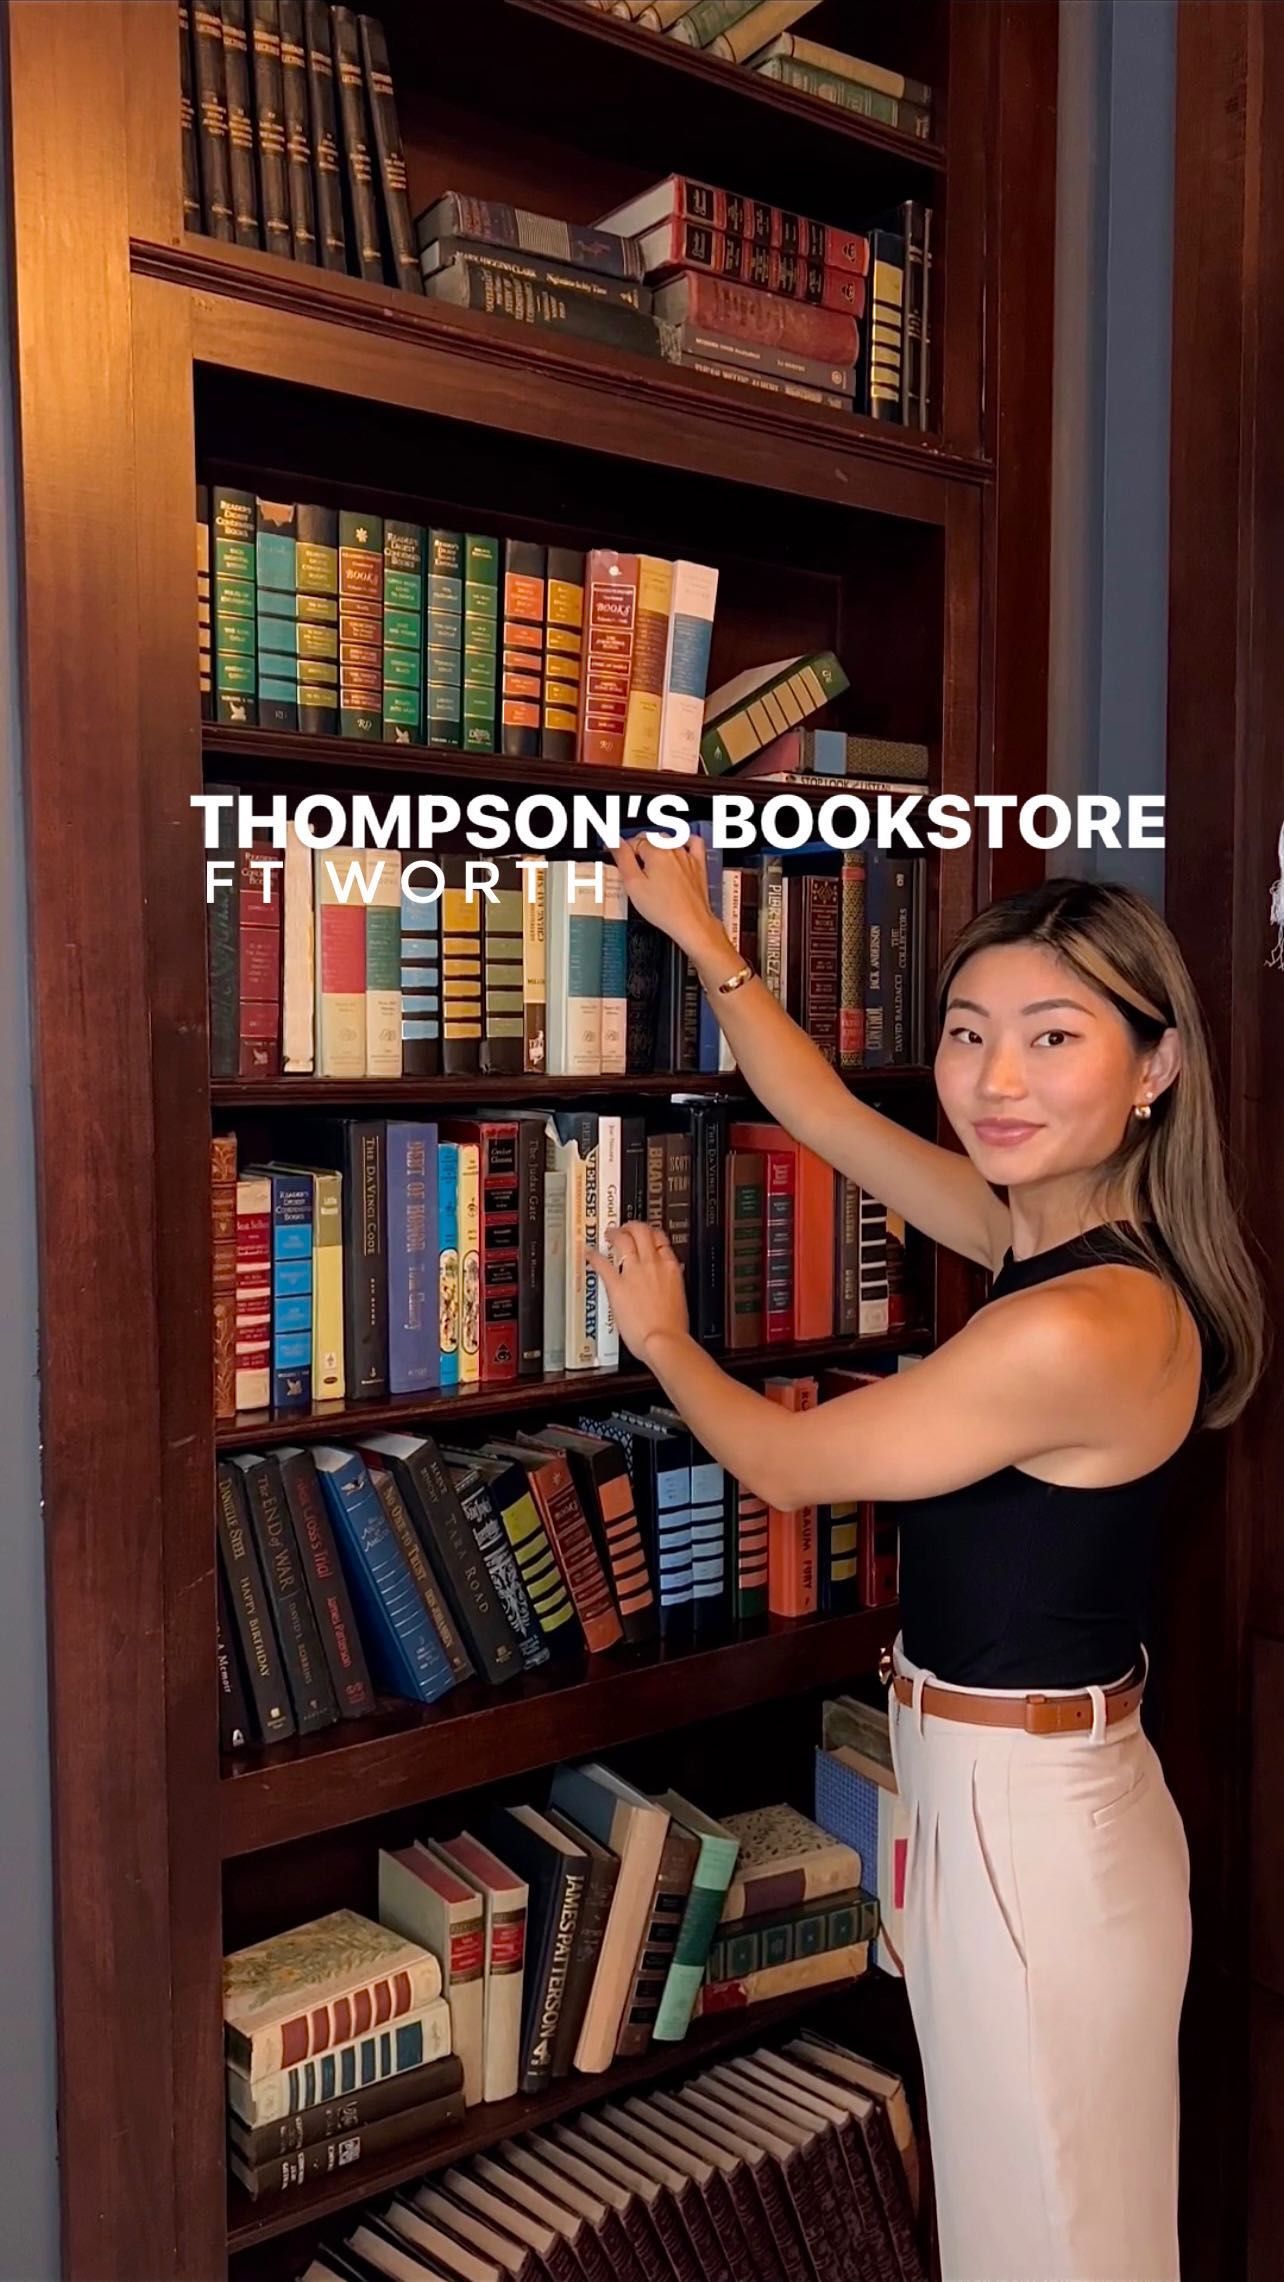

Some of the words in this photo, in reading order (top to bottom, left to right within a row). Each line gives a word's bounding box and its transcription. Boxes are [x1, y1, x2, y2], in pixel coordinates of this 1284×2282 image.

[596, 602, 631, 617] BOOKS
[869, 924, 881, 968] ANDERSON
[899, 907, 908, 969] COLLECTORS
[895, 973, 903, 1022] BALDACCI
[895, 1022, 903, 1053] DAVID
[366, 1138, 376, 1161] THE
[406, 1140, 425, 1177] DEBT
[529, 1140, 539, 1161] The
[529, 1162, 539, 1193] Judas
[648, 1147, 662, 1194] BRAD
[406, 1181, 425, 1200] OF
[528, 1195, 539, 1221] Gate
[606, 1183, 617, 1219] Good
[406, 1202, 426, 1254] HONOR
[648, 1199, 662, 1231] THO
[366, 1222, 376, 1255] CODE
[585, 1224, 597, 1341] DIIONARY
[218, 1477, 241, 1528] DANIELLE
[229, 1526, 246, 1561] STEEL
[263, 1500, 282, 1538] END
[274, 1549, 296, 1592] WAR
[465, 1566, 490, 1615] ROAD
[804, 1559, 813, 1591] FURY
[240, 1576, 256, 1615] HAPPY
[248, 1618, 270, 1678] BIRTHDAY
[216, 1654, 232, 1694] Memoir
[560, 1873, 585, 1933] JAMES
[540, 1930, 574, 2039] PATTERSON
